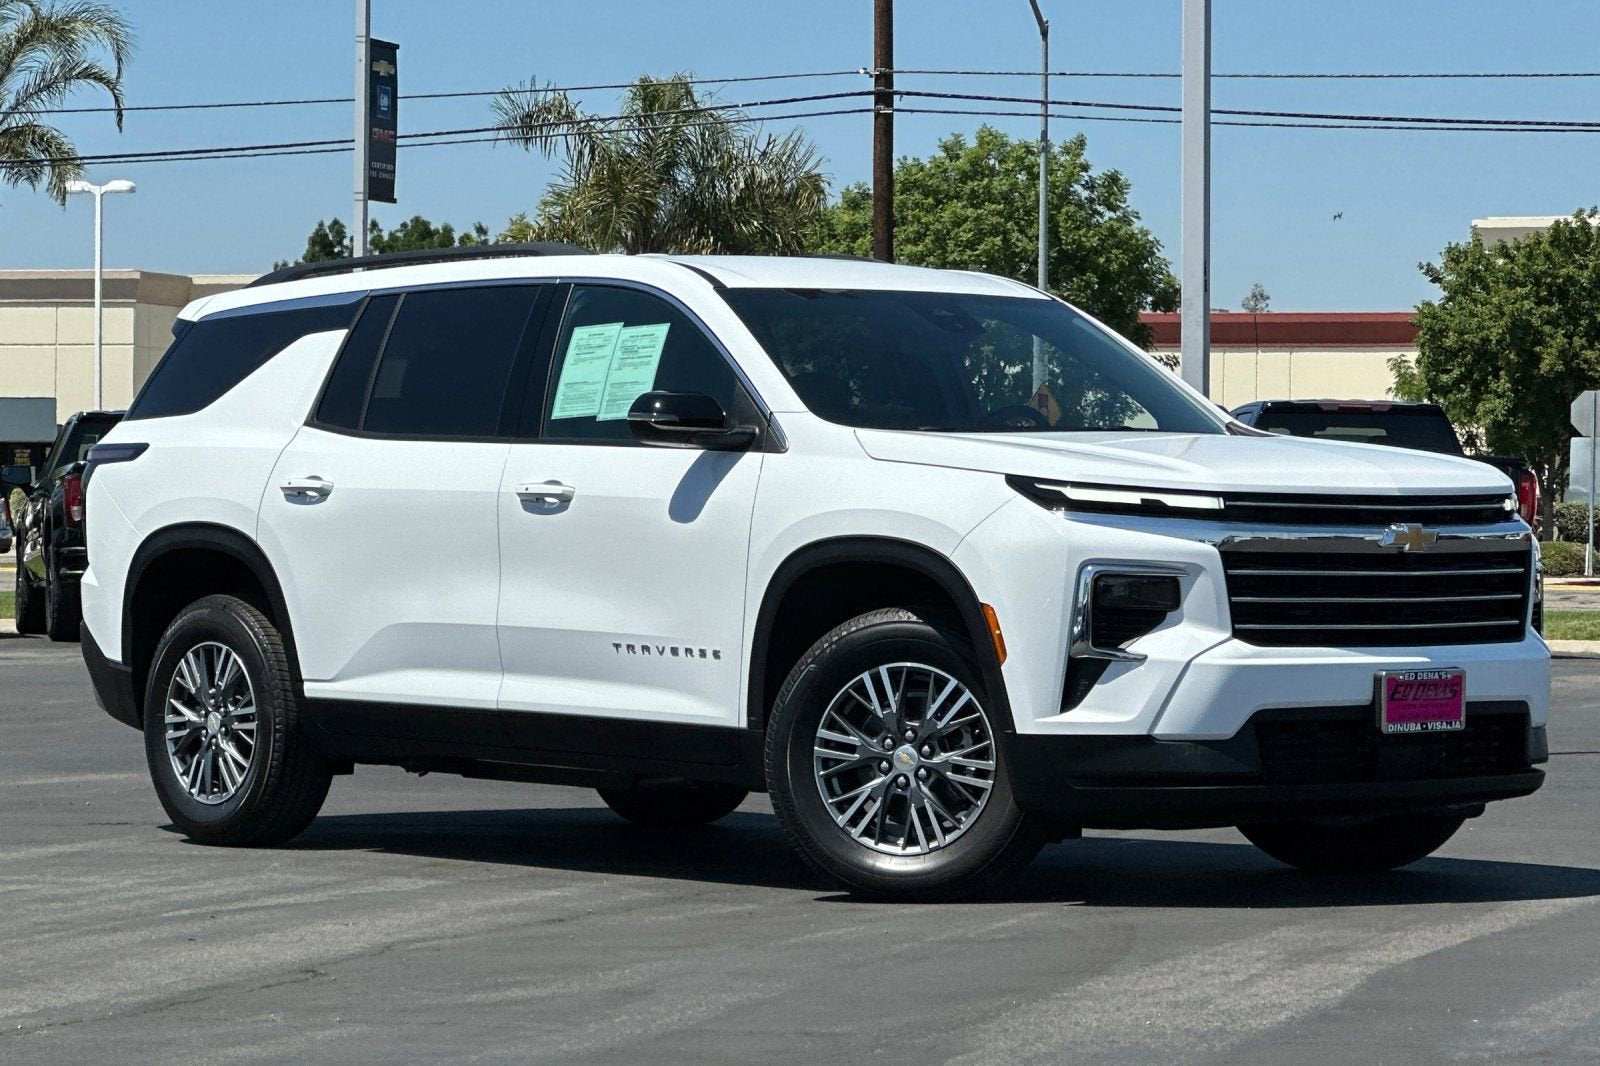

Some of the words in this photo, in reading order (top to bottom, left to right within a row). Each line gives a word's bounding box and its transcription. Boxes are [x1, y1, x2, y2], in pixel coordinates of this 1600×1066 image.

[372, 127, 395, 143] GMC
[612, 643, 721, 660] TRAVERSE
[1388, 722, 1421, 732] DINUBA
